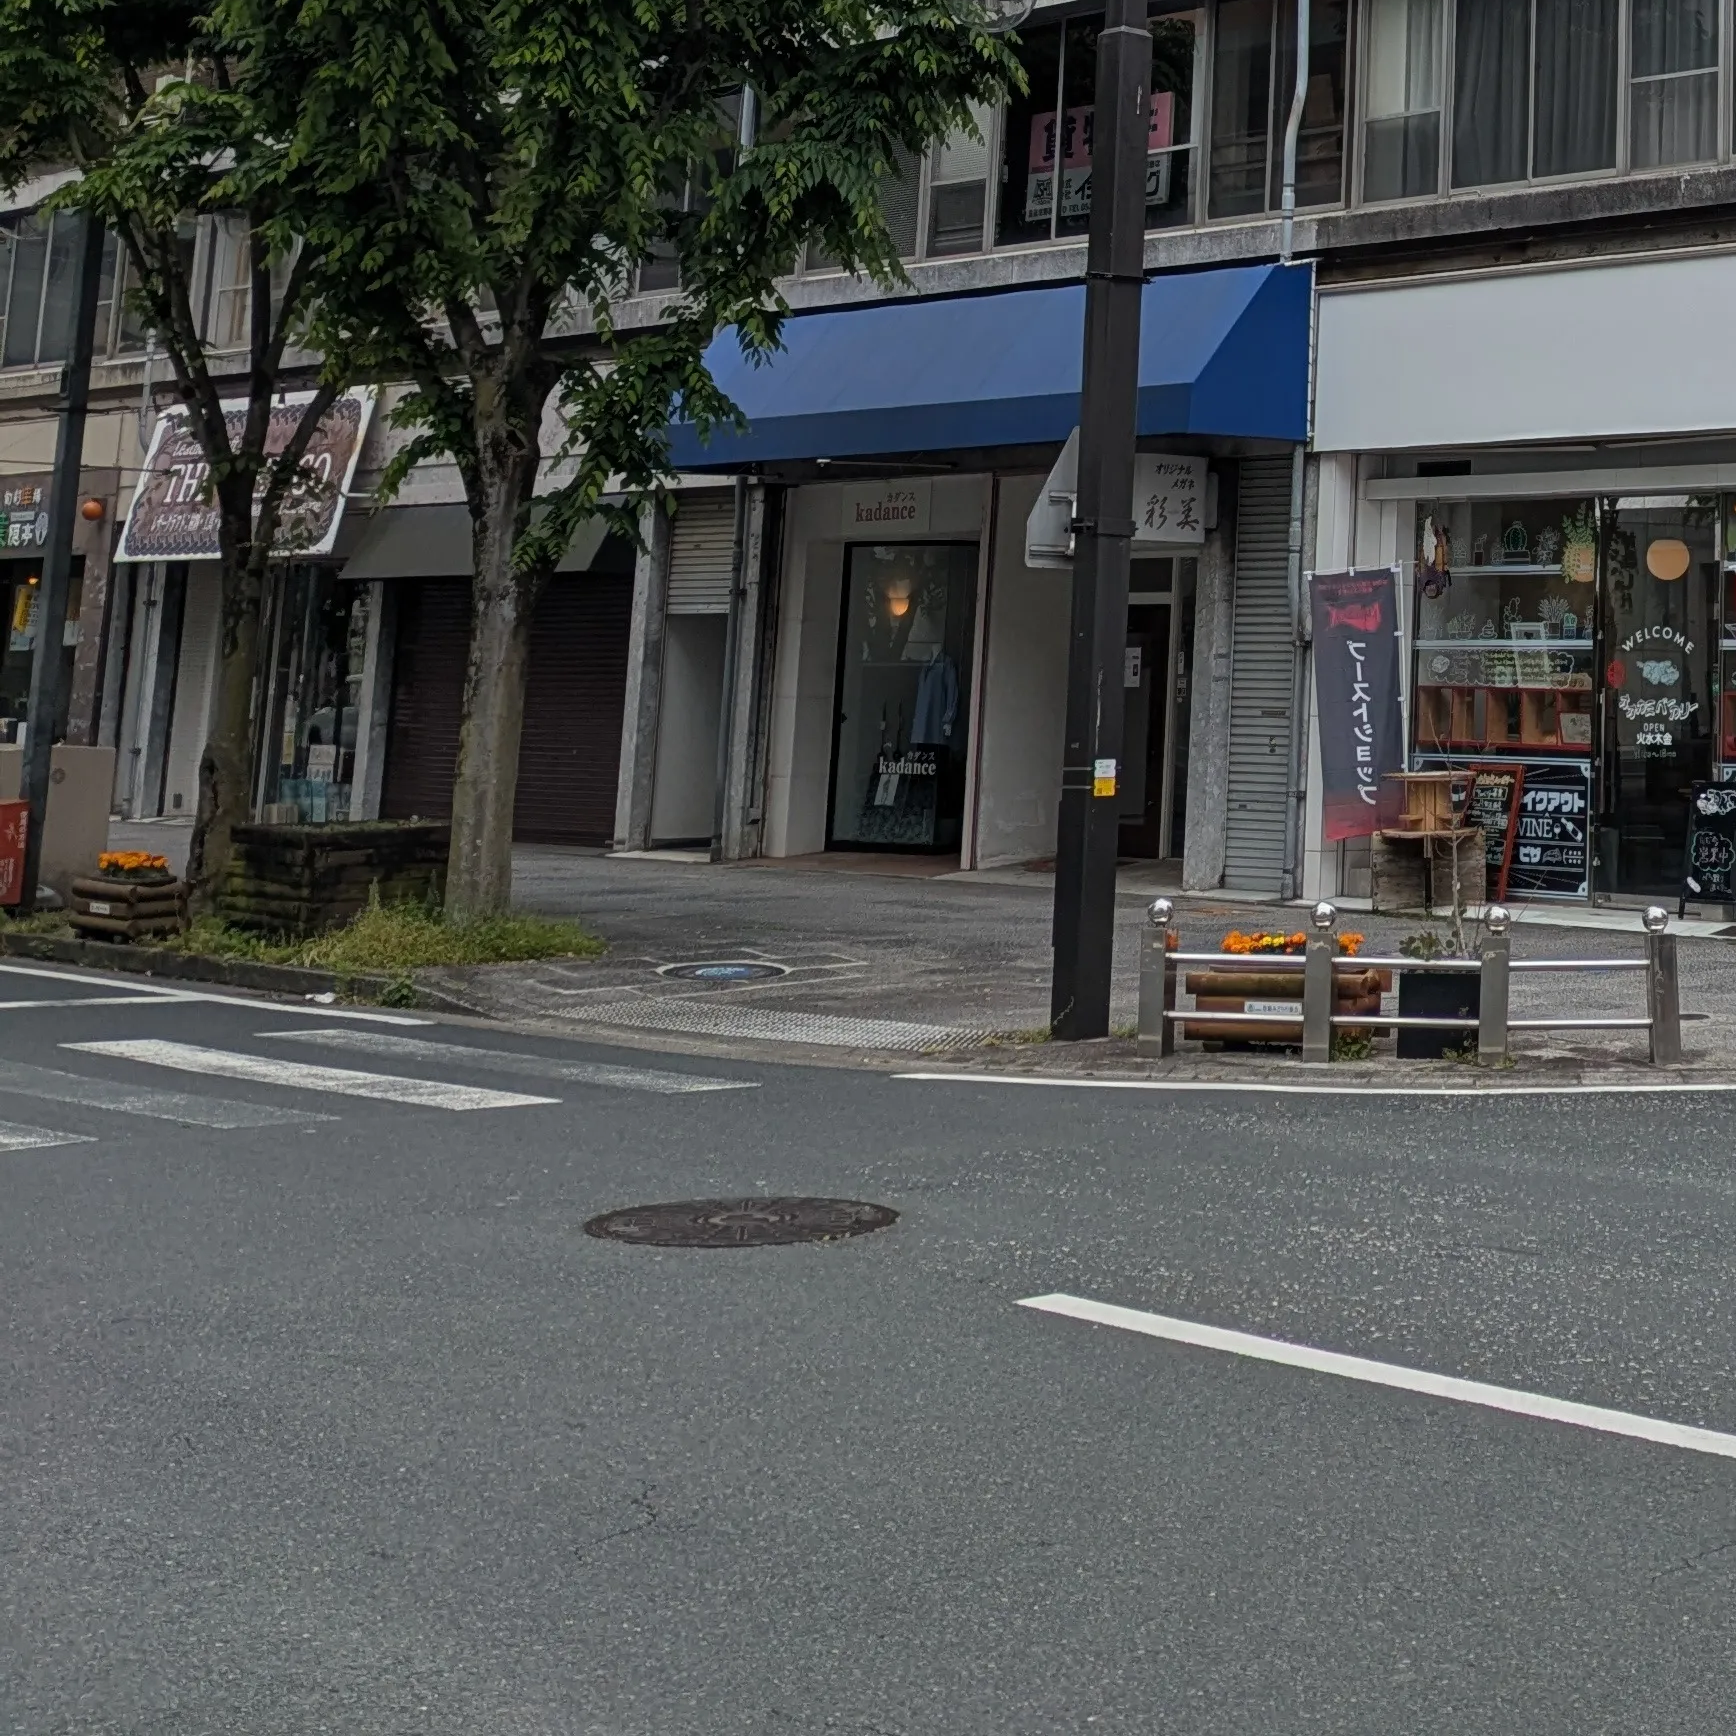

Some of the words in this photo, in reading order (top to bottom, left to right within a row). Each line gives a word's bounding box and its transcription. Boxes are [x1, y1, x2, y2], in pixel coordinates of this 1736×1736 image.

[1155, 462, 1194, 476] オリジナル
[1170, 478, 1195, 490] メガネ
[886, 491, 916, 503] カダンス
[855, 500, 916, 522] kadance
[1144, 494, 1200, 532] 彩美
[1621, 625, 1695, 655] WELCOME
[1643, 723, 1665, 732] OPEN
[1635, 732, 1673, 745] 火水木金
[906, 750, 935, 761] カダンス
[878, 756, 937, 775] kadance
[1523, 790, 1586, 813] イクアウト
[1698, 846, 1729, 864] 営業中
